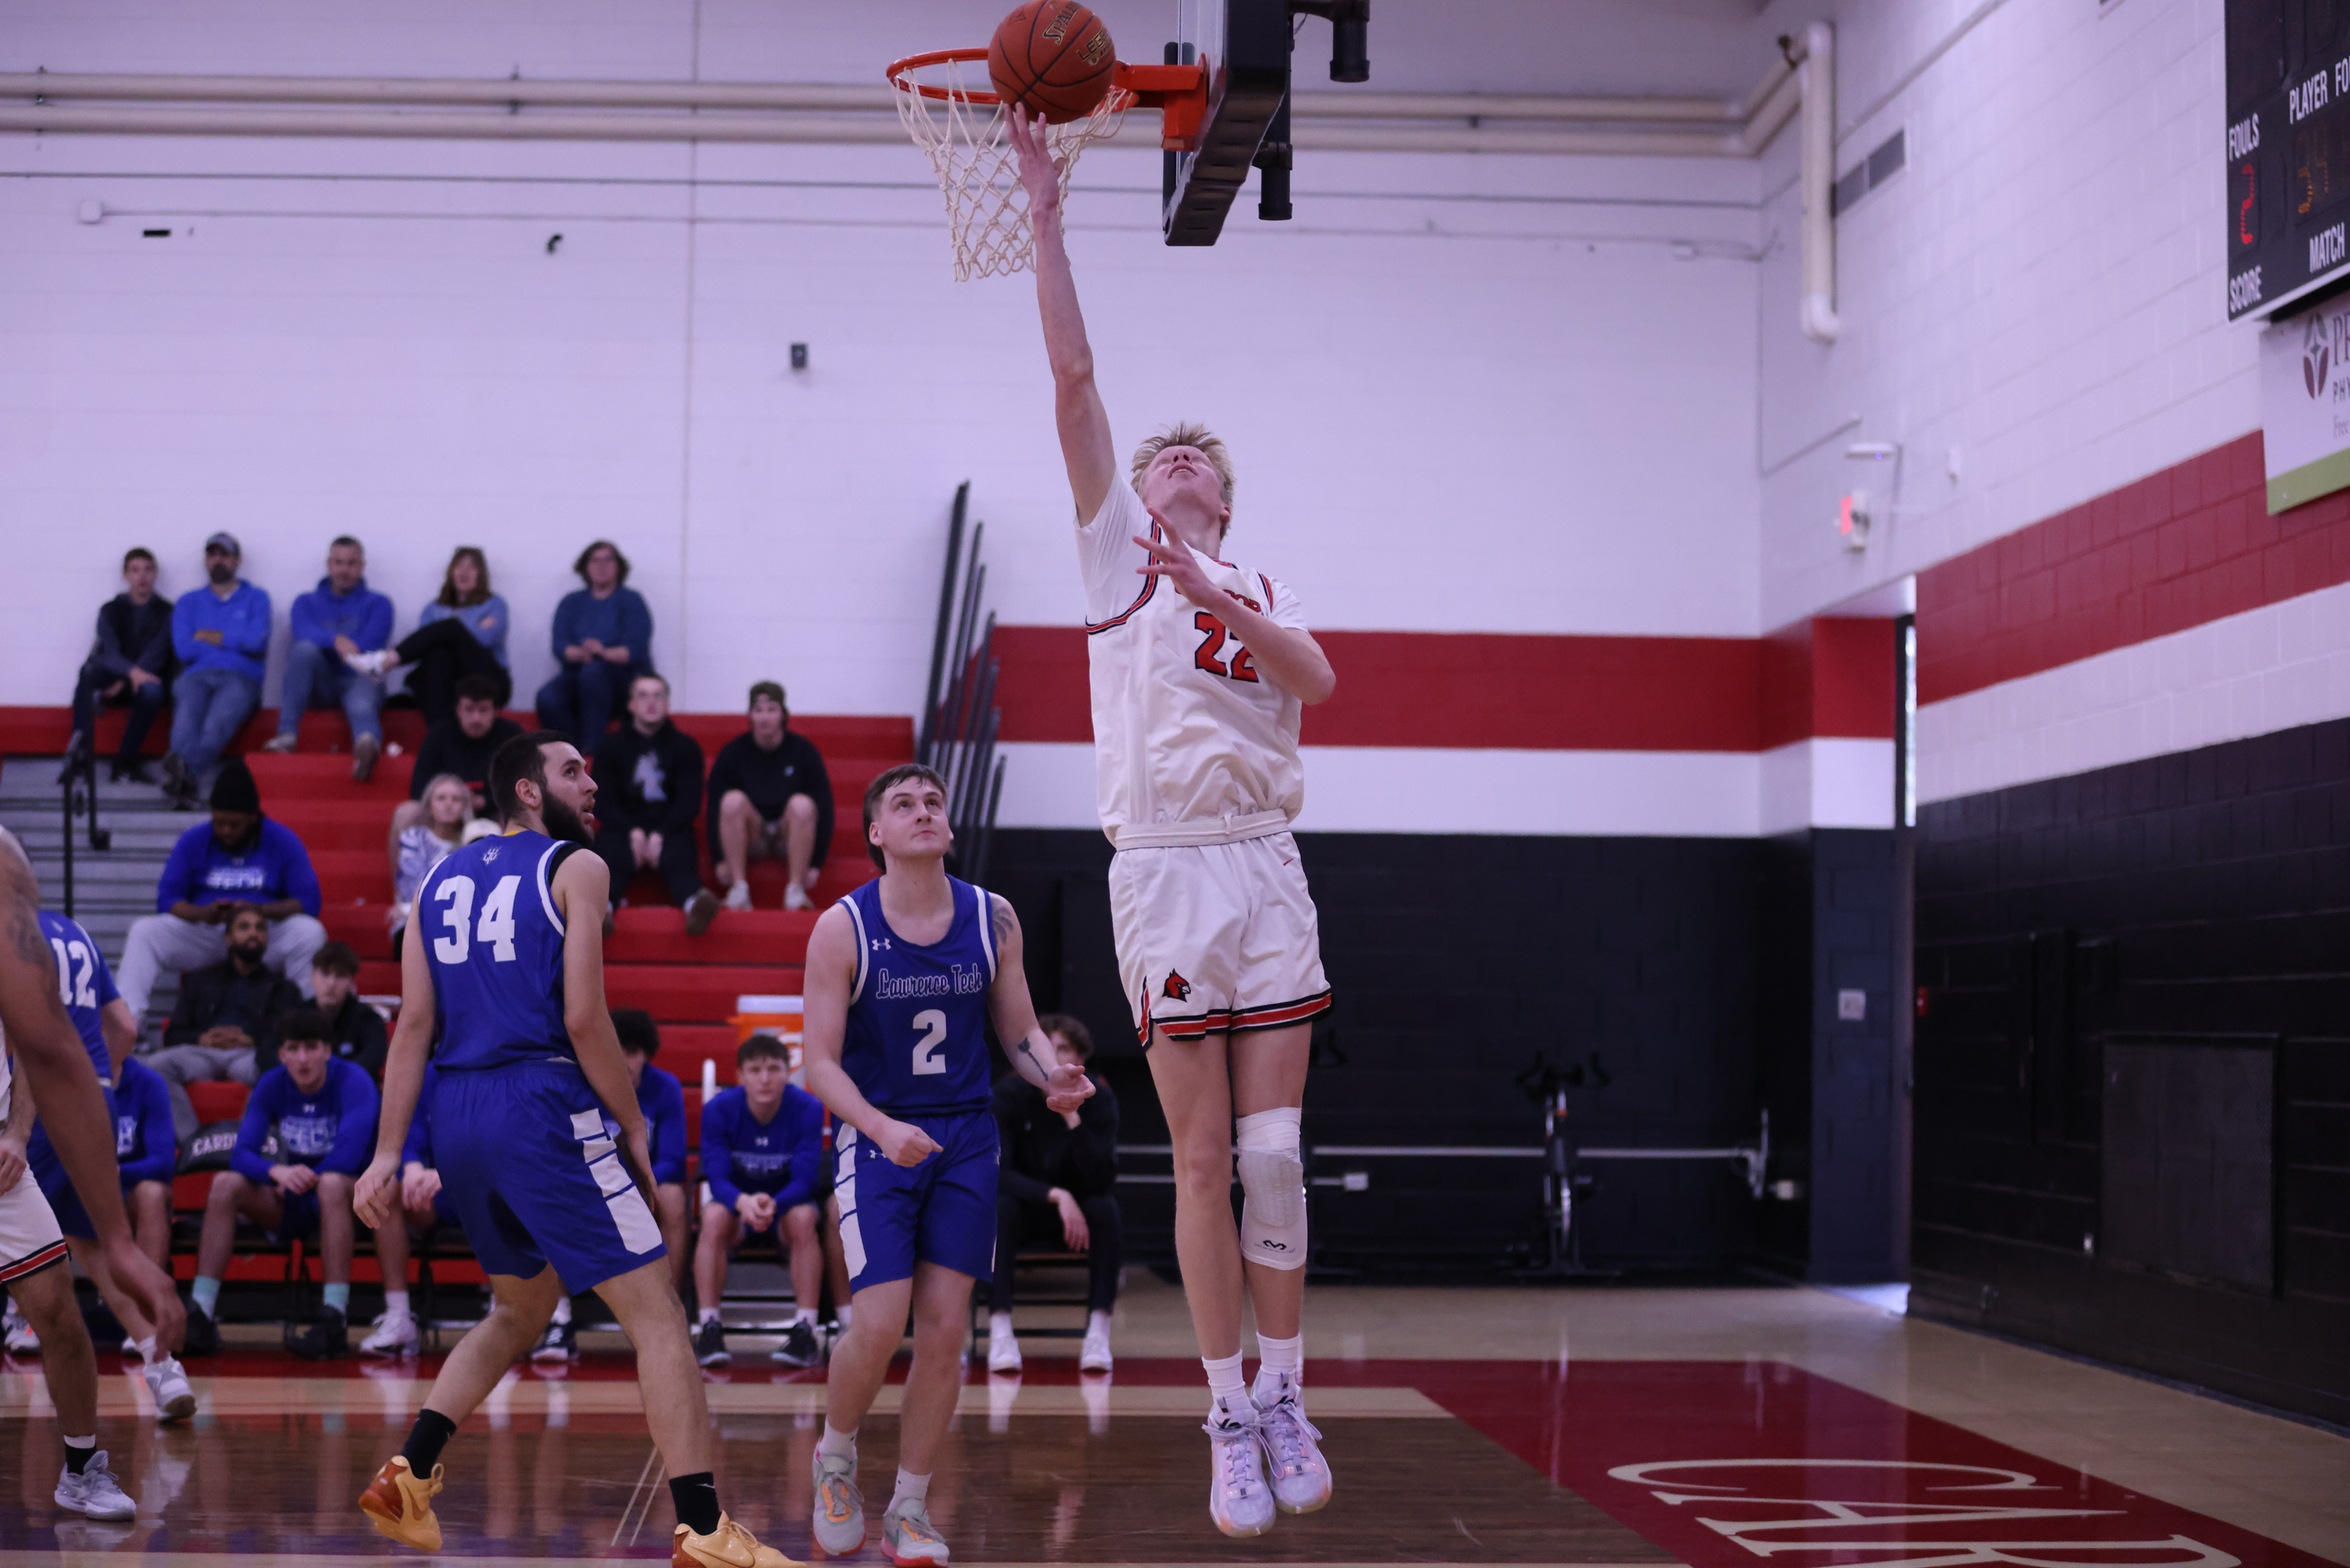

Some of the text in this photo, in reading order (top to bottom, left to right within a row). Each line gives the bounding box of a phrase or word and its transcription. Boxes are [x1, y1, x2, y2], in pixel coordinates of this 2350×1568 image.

[2289, 56, 2350, 125] PLAYER FO
[2228, 112, 2260, 162] FOULS
[2309, 221, 2346, 274] MATCH
[2229, 264, 2262, 313] SCORE
[1194, 610, 1260, 683] 22
[433, 874, 522, 965] 34
[50, 936, 97, 1011] 12
[876, 962, 983, 999] Lawrence Tech
[912, 1008, 947, 1076] 2
